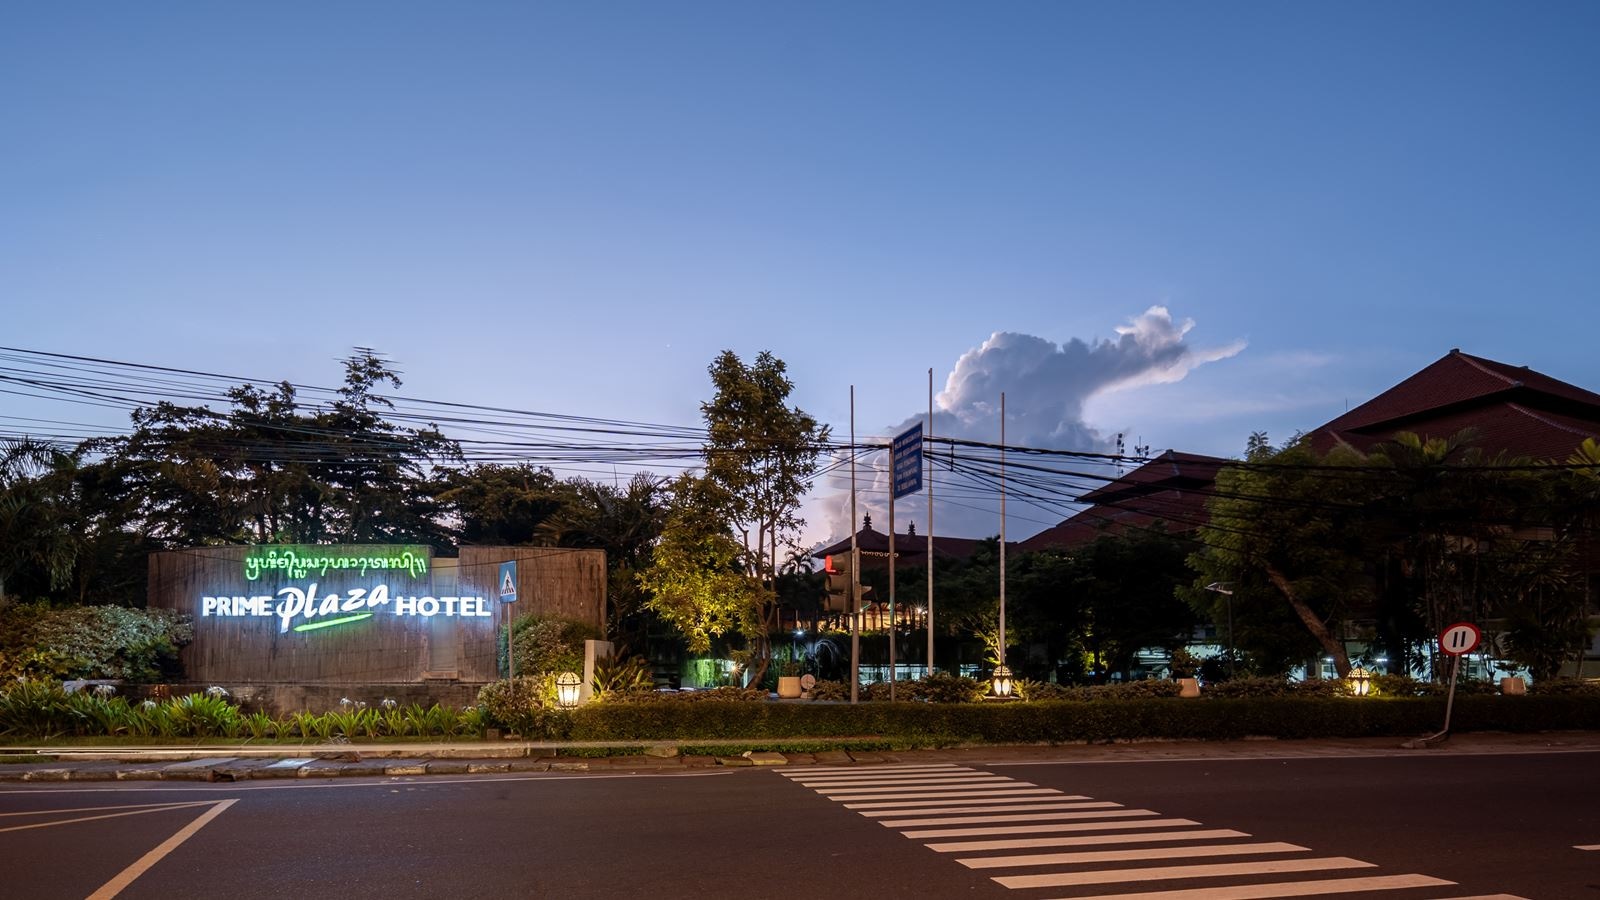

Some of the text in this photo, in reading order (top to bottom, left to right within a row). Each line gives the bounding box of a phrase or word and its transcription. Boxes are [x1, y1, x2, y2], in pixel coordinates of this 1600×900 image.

[202, 582, 492, 633] PRIME Plaza HOTEL
